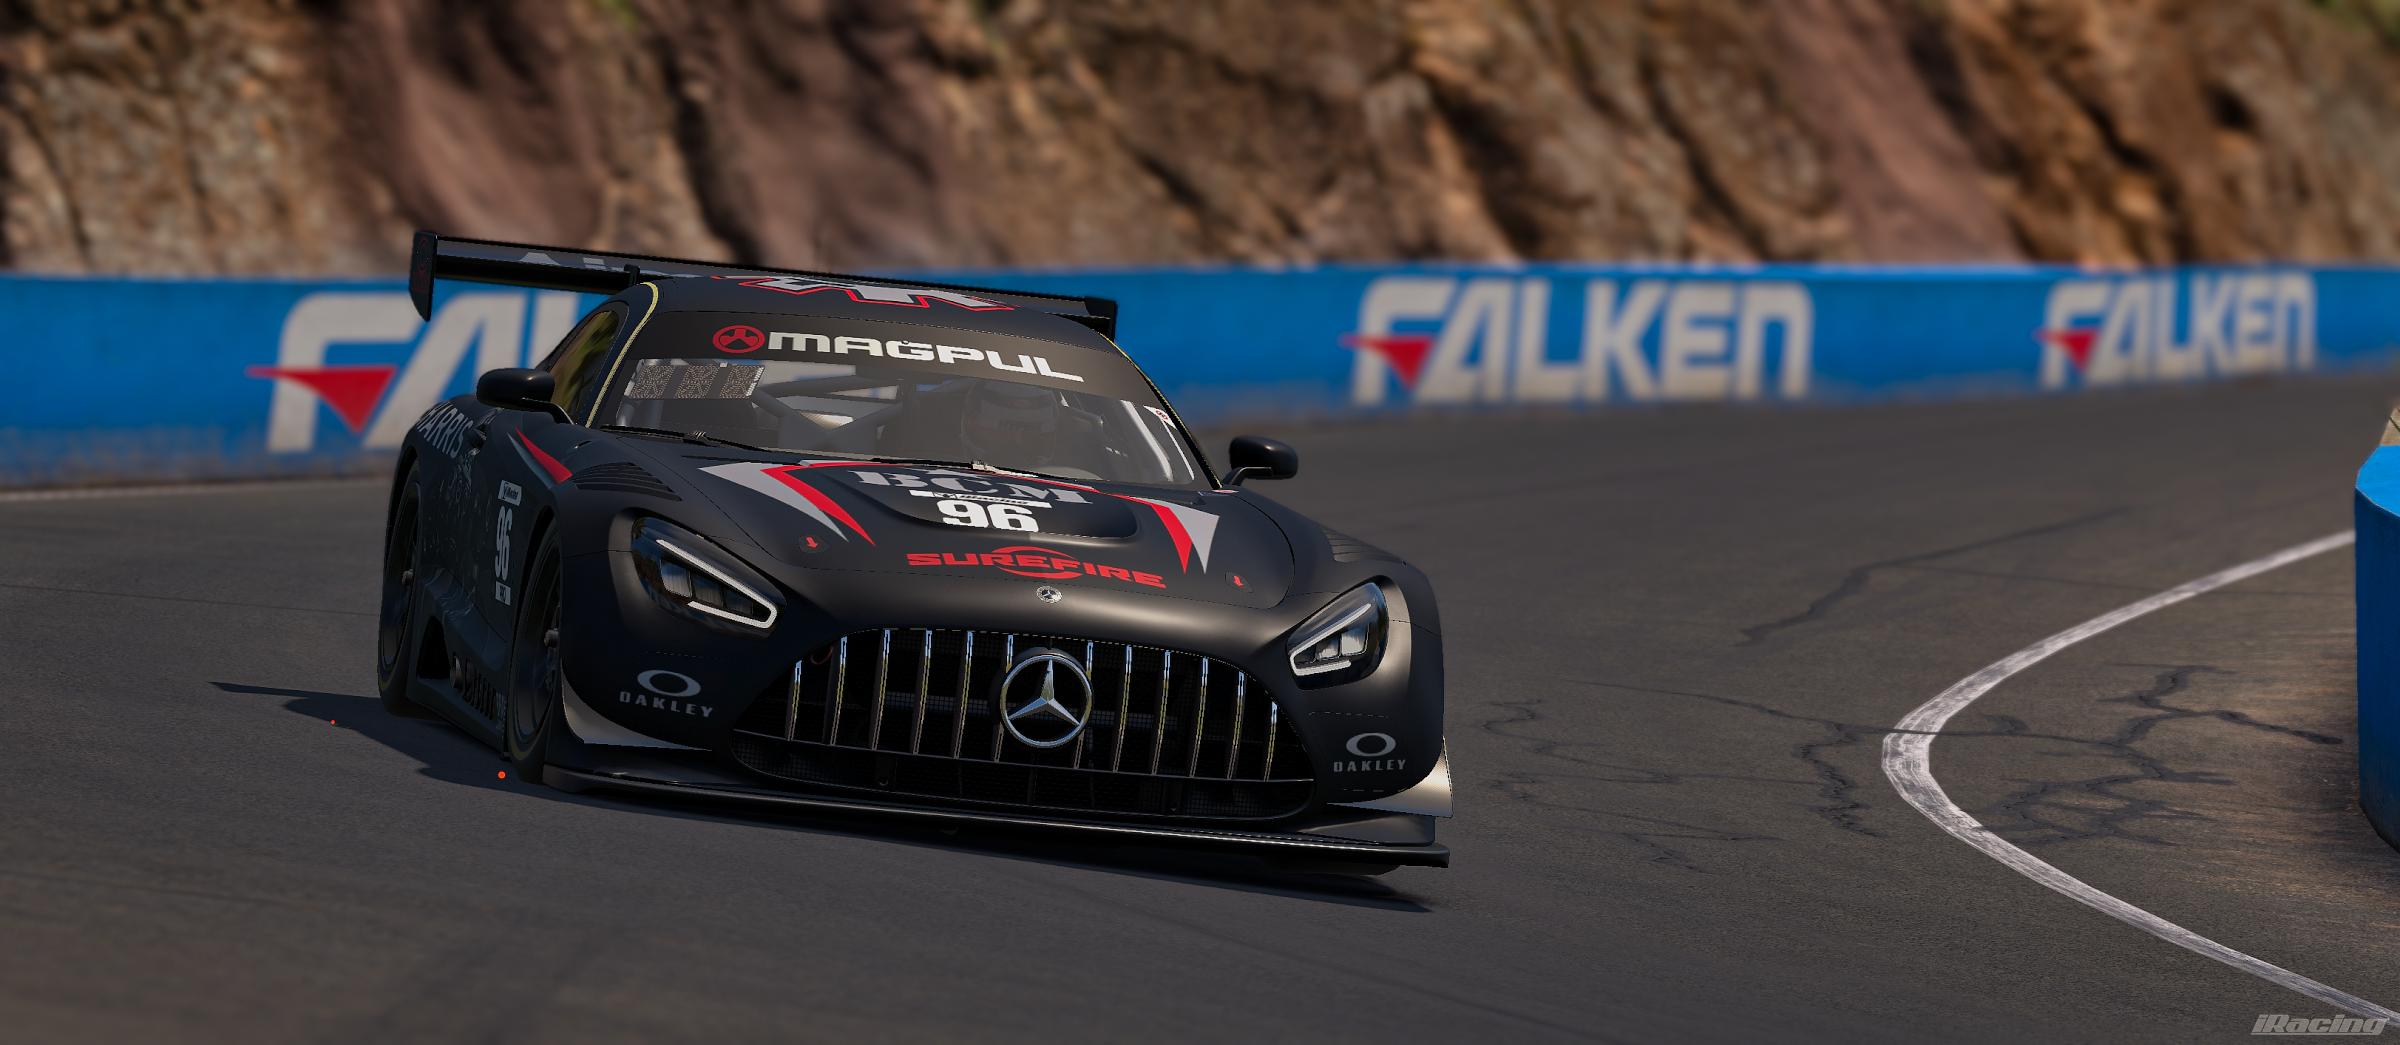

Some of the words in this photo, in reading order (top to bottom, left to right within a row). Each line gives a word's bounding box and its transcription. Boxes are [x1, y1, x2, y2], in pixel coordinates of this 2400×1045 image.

[1353, 279, 1814, 404] FALKEN
[2043, 272, 2315, 389] FALKEN
[767, 331, 1084, 382] MAGPUL
[847, 469, 1093, 505] BCM
[936, 499, 1039, 533] 96
[495, 505, 513, 581] 96
[905, 553, 1167, 589] SUREFIRE
[619, 691, 714, 719] OAKLEY
[1333, 758, 1408, 773] OAKLEY
